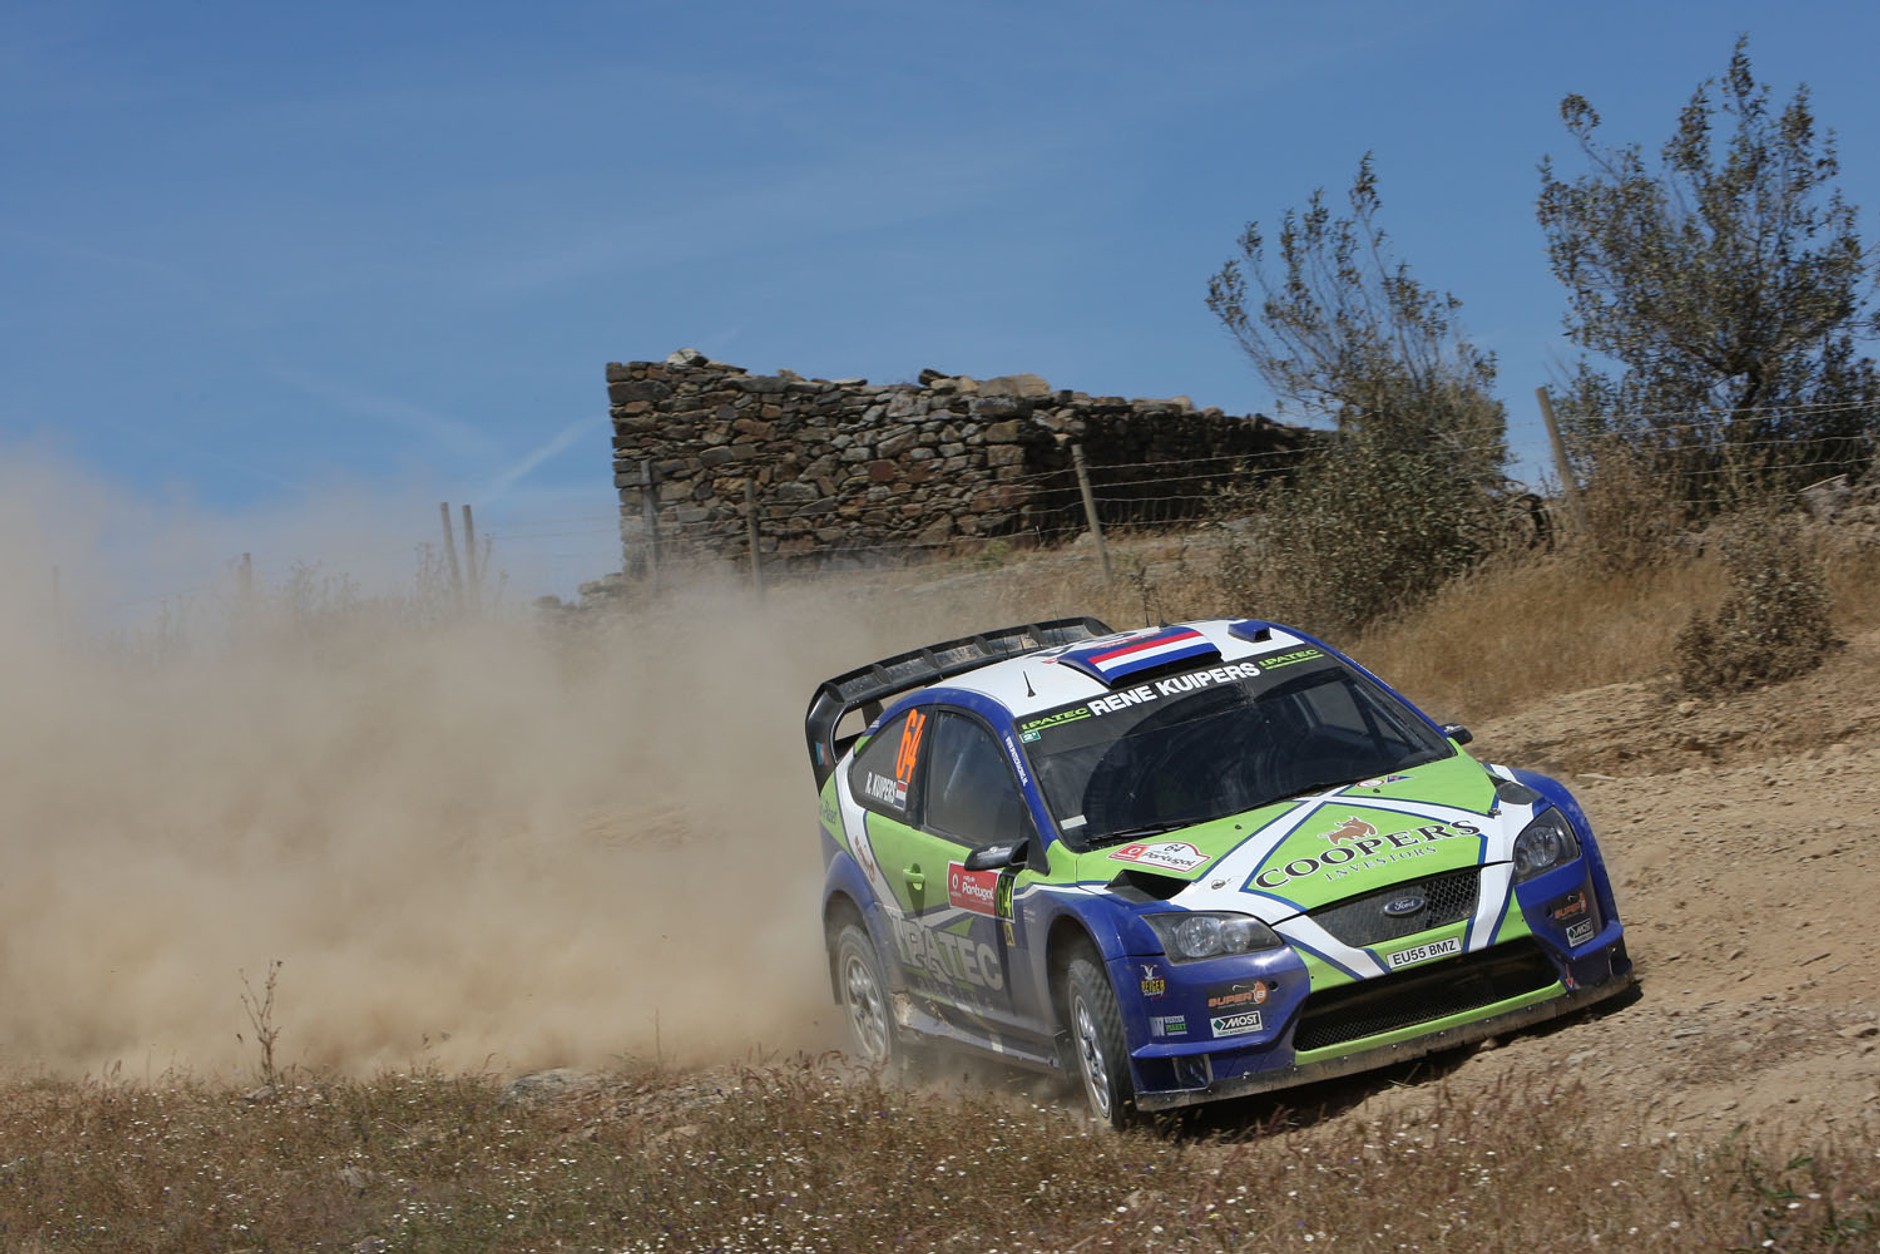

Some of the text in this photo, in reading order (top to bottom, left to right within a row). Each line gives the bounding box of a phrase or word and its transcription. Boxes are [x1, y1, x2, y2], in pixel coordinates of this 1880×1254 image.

[1258, 649, 1319, 669] IPATEC
[1087, 662, 1262, 716] RENE KUIPERS
[1021, 707, 1088, 730] IPATEC
[896, 709, 926, 783] 64
[1164, 843, 1186, 853] 64
[1255, 818, 1481, 889] COOPERS
[1142, 852, 1196, 866] Portugal
[1326, 846, 1438, 882] INVESTORS
[962, 882, 994, 901] Portugal
[1393, 898, 1416, 911] Ford
[1393, 939, 1457, 966] EU55 BMZ
[1208, 992, 1253, 1007] SUPER
[1225, 1014, 1258, 1030] MOST
